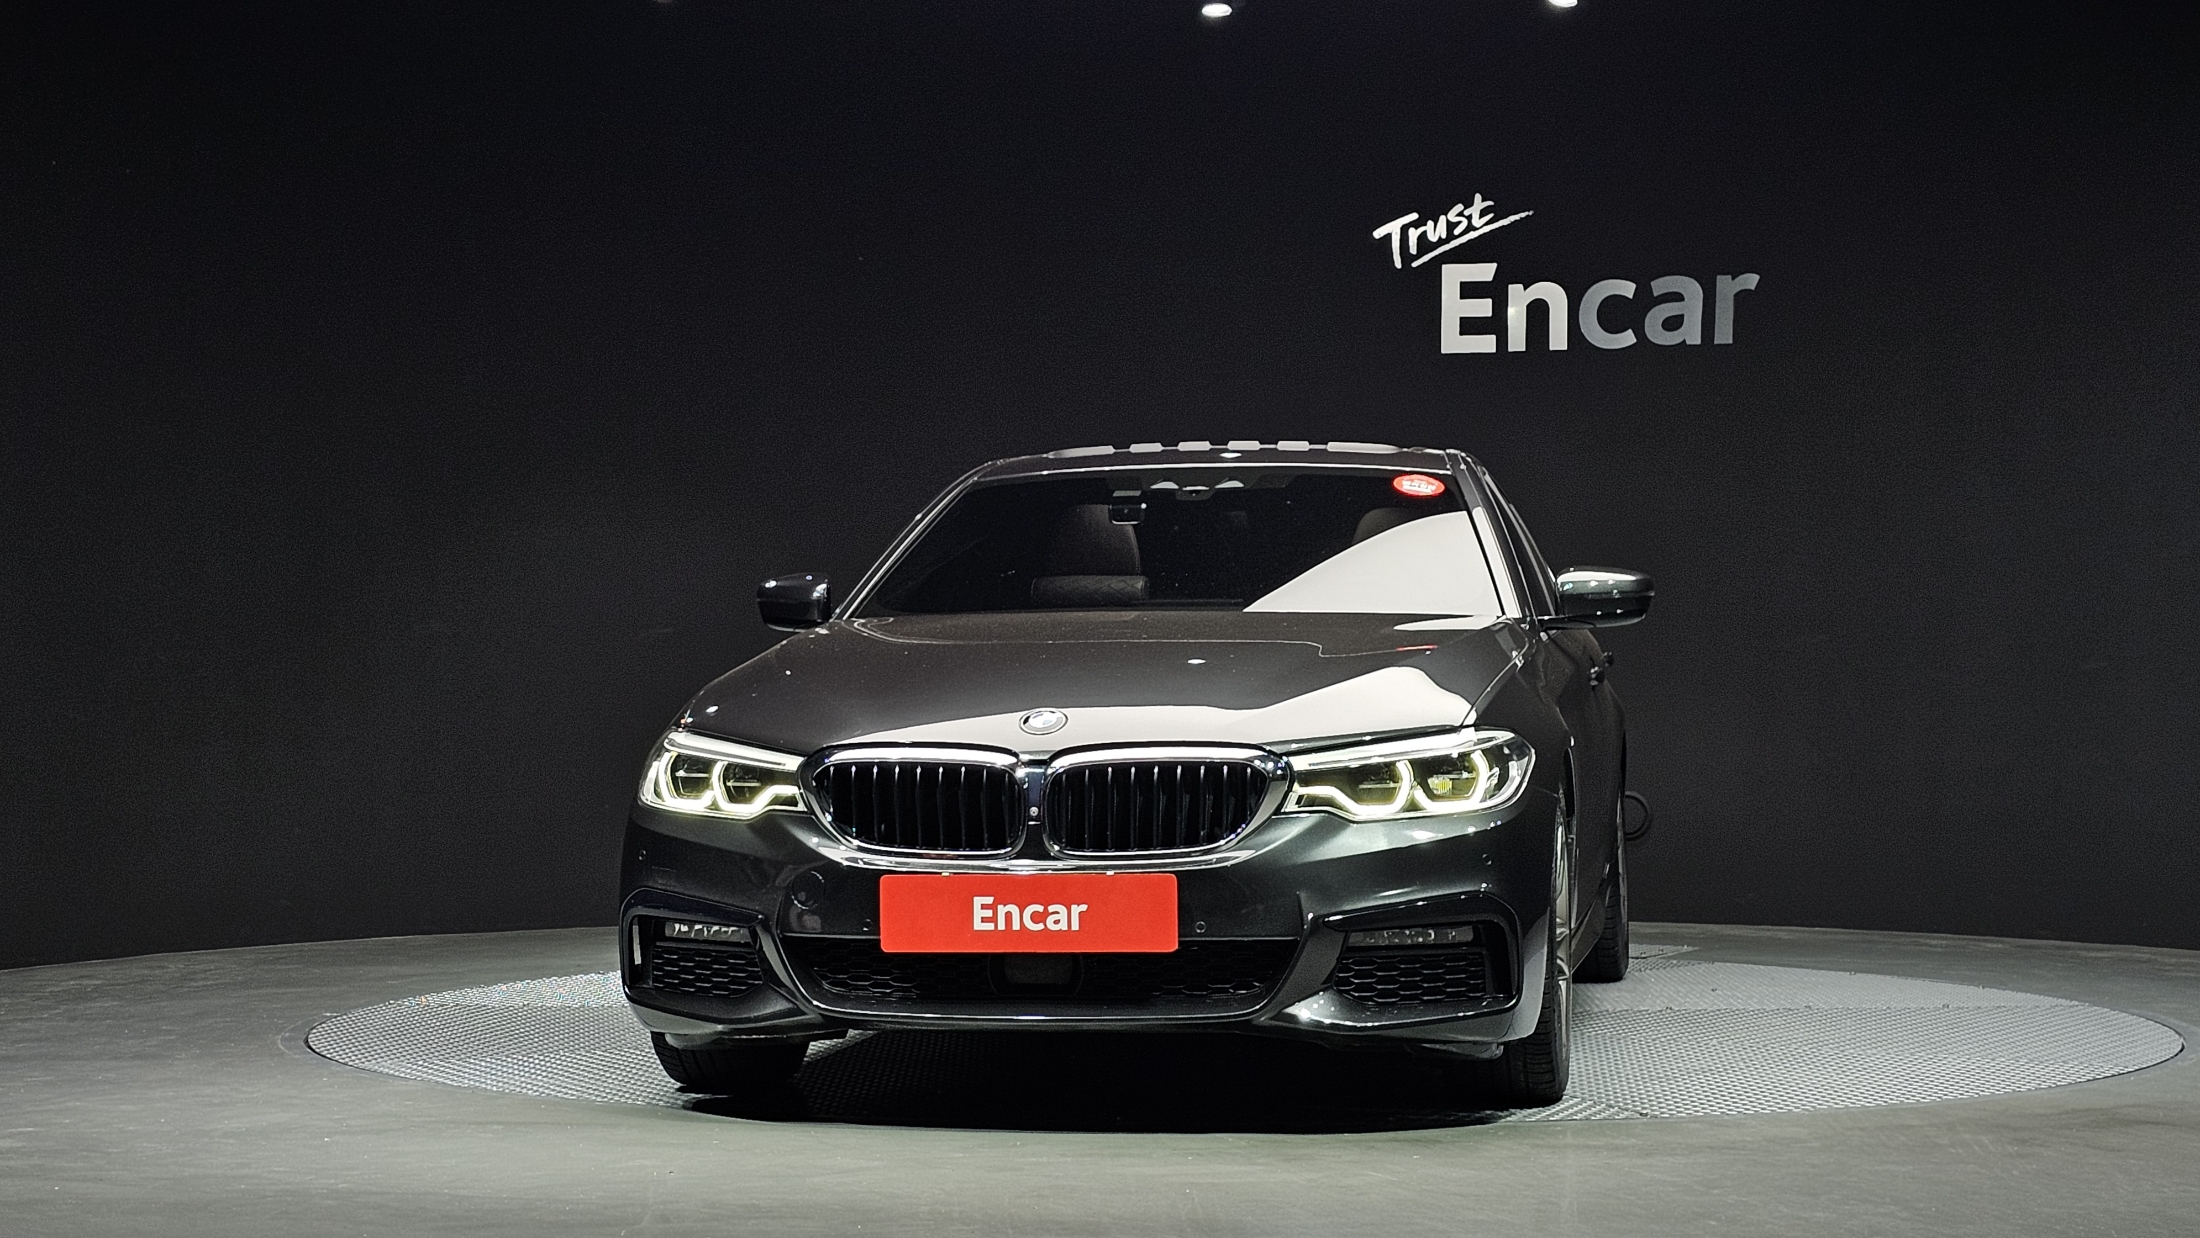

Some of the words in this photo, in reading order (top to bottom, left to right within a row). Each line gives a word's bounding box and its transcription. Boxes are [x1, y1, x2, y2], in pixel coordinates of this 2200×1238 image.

[1373, 193, 1495, 269] Trust
[1441, 263, 1760, 354] Encar
[973, 896, 1088, 931] Encar
